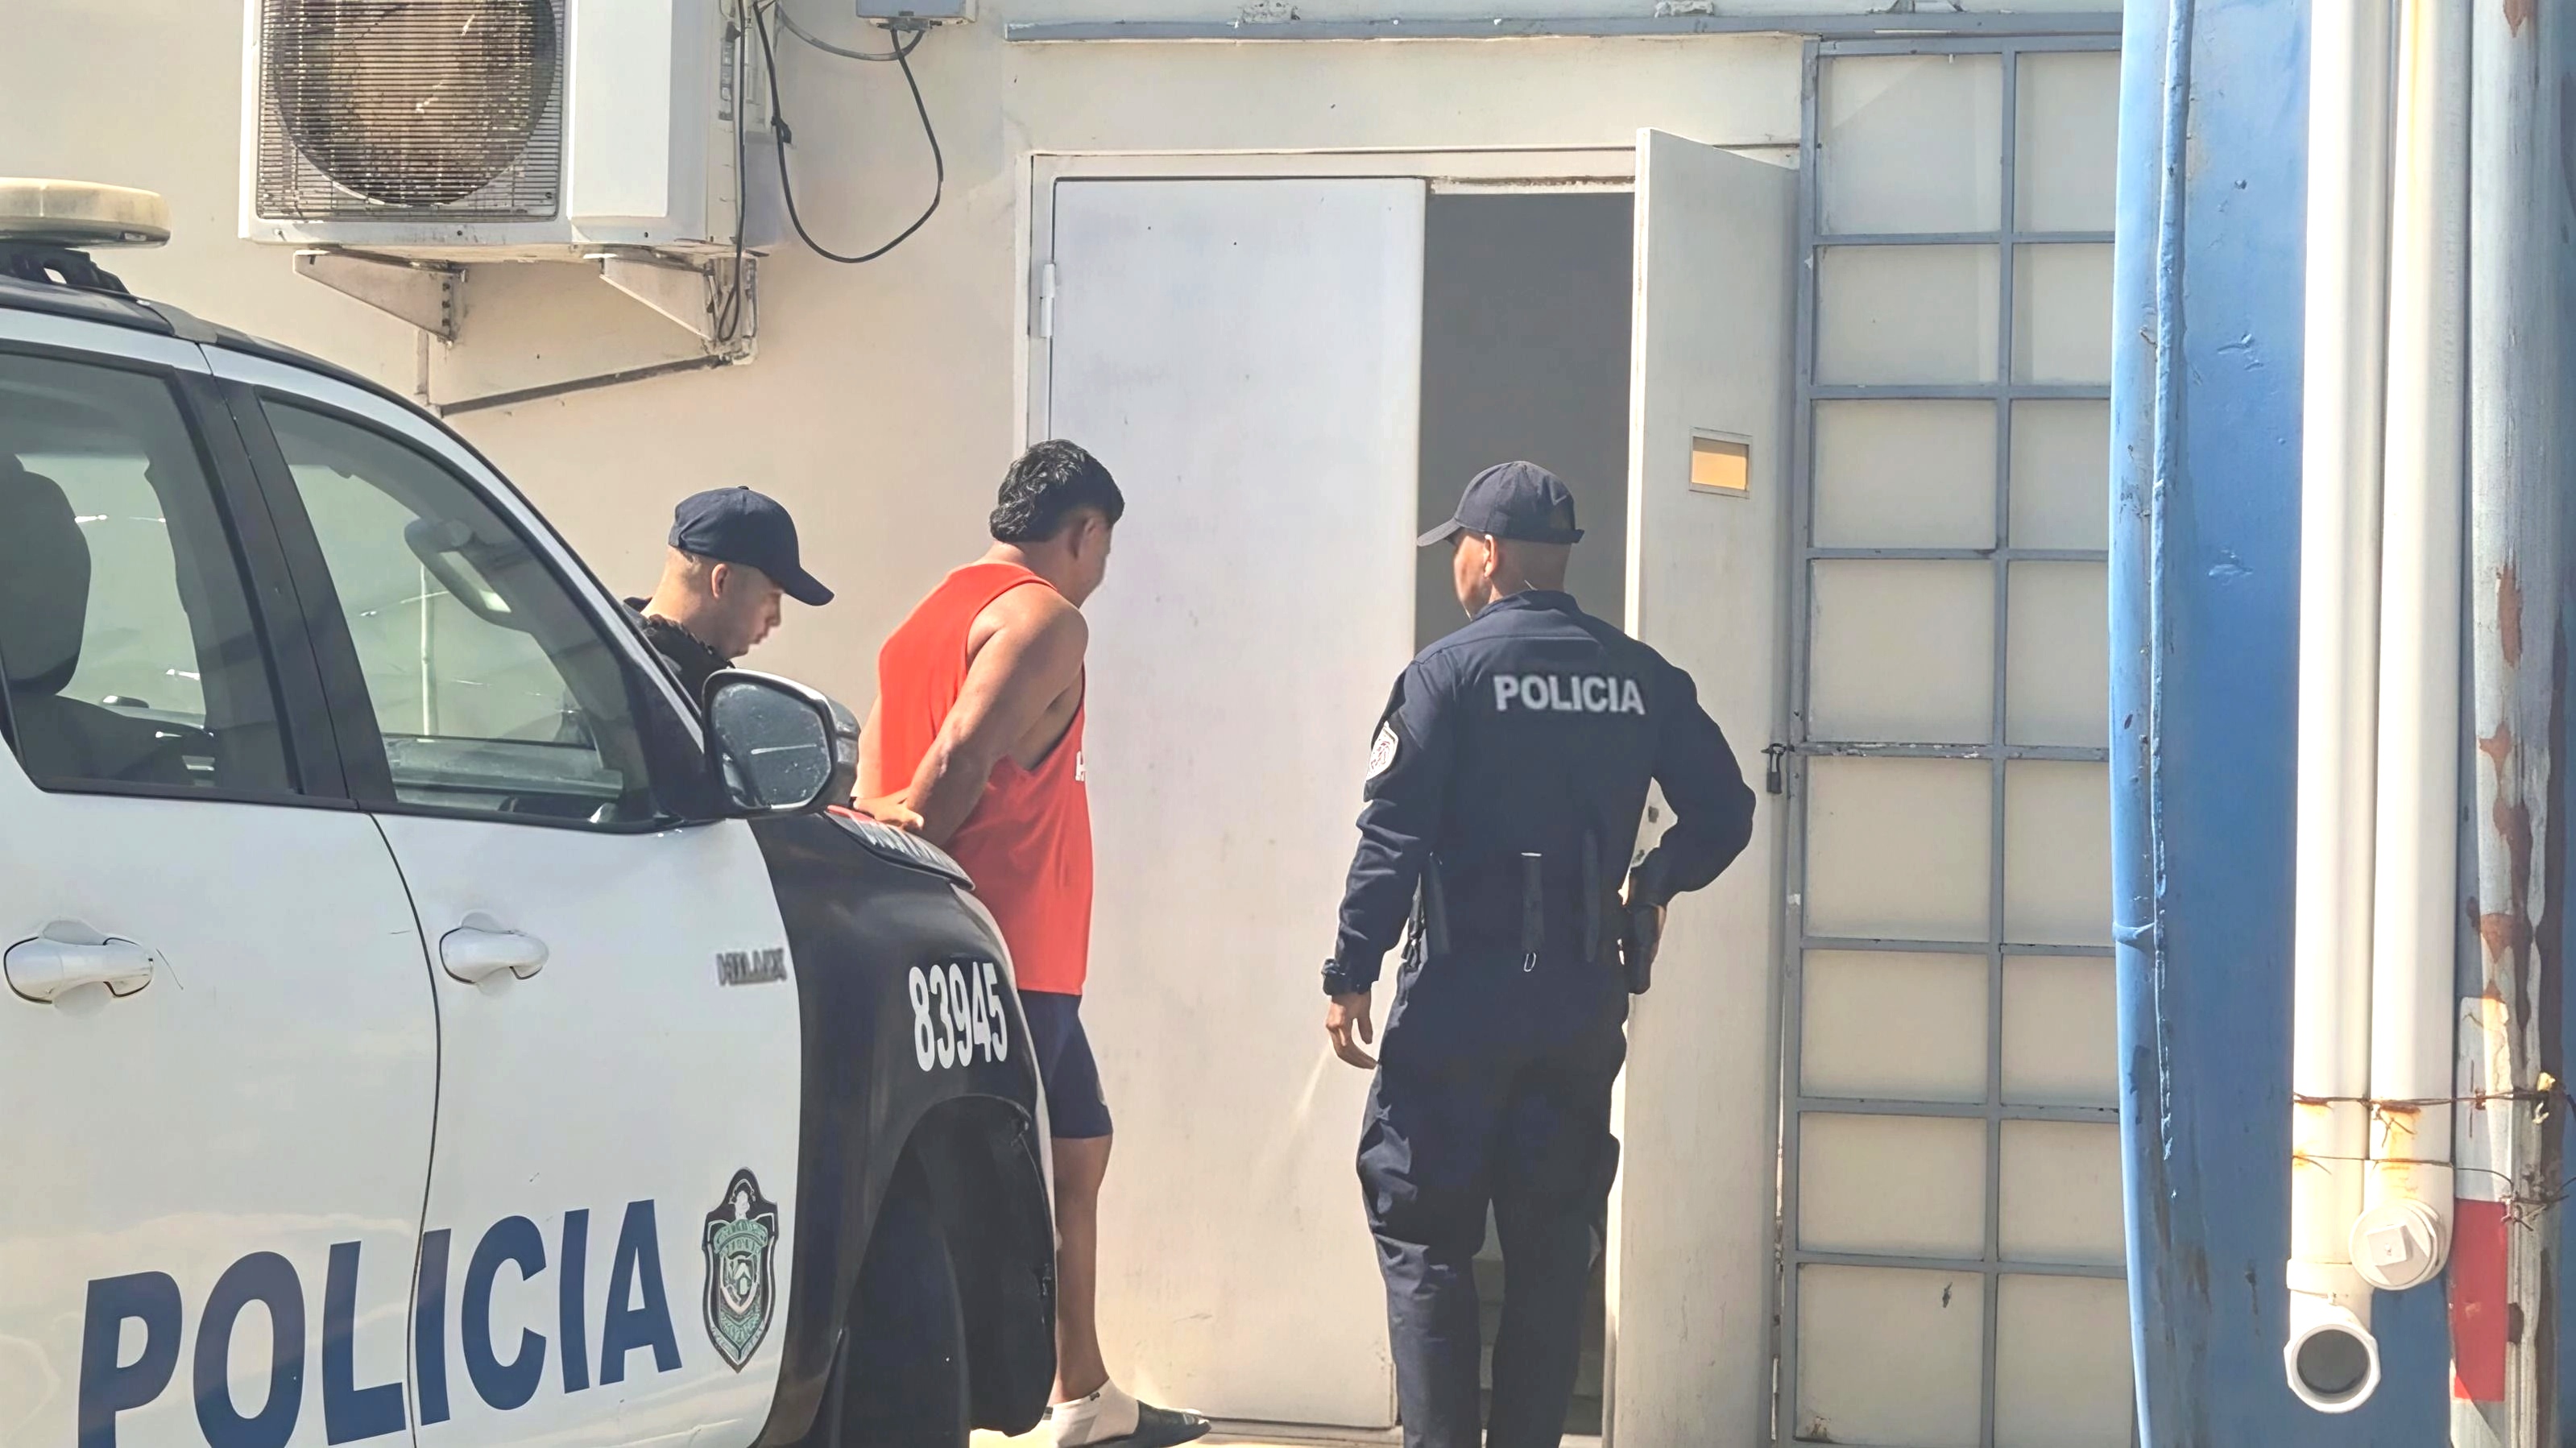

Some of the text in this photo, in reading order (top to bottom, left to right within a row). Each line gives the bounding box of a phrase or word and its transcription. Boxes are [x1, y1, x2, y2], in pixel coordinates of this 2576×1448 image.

[1493, 674, 1646, 715] POLICIA
[909, 961, 1008, 1072] 83945
[77, 1198, 683, 1448] POLICIA
